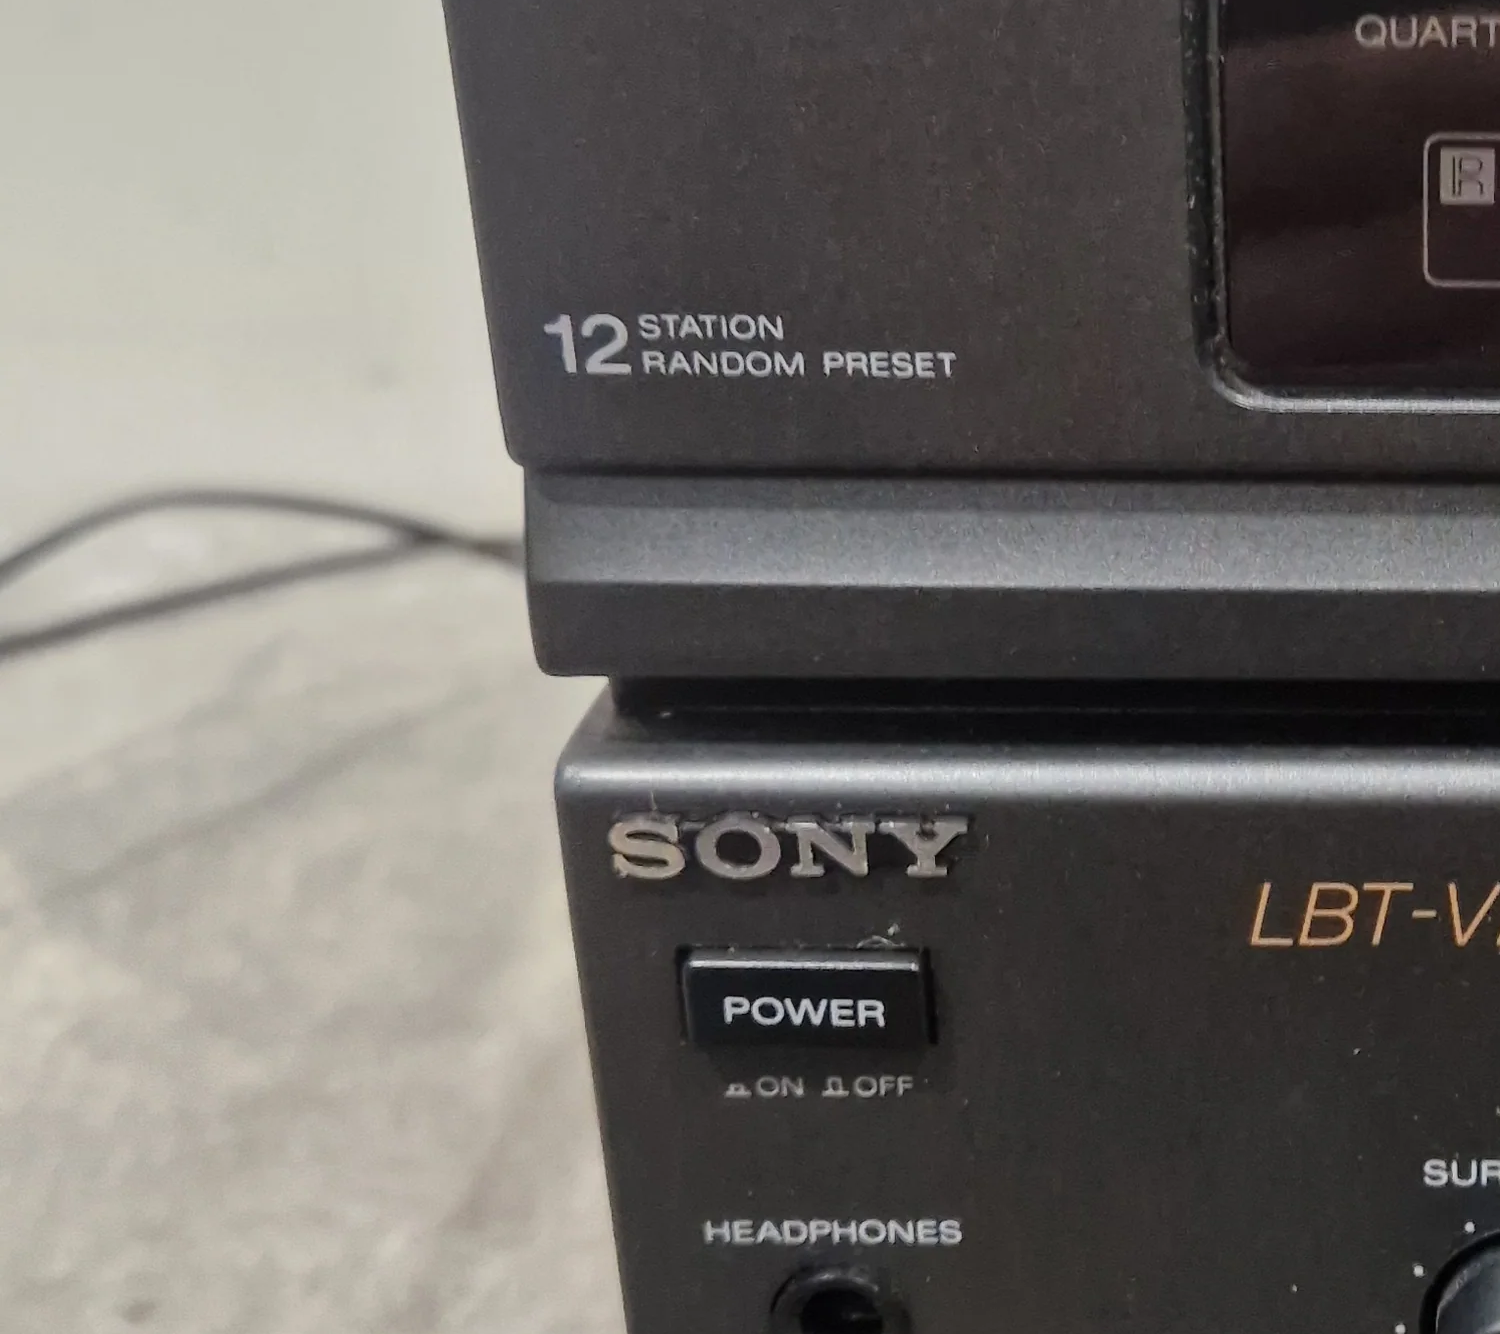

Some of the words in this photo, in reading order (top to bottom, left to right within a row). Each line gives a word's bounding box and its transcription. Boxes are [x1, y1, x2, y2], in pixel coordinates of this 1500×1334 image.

[638, 313, 784, 341] STATION
[543, 313, 632, 376] 12
[640, 350, 805, 378] RANDOM
[822, 351, 957, 379] PRESET
[607, 812, 969, 879] SONY
[723, 996, 886, 1028] POWER
[760, 1077, 804, 1098] ON
[853, 1077, 914, 1098] OFF
[703, 1219, 963, 1245] HEADPHONES
